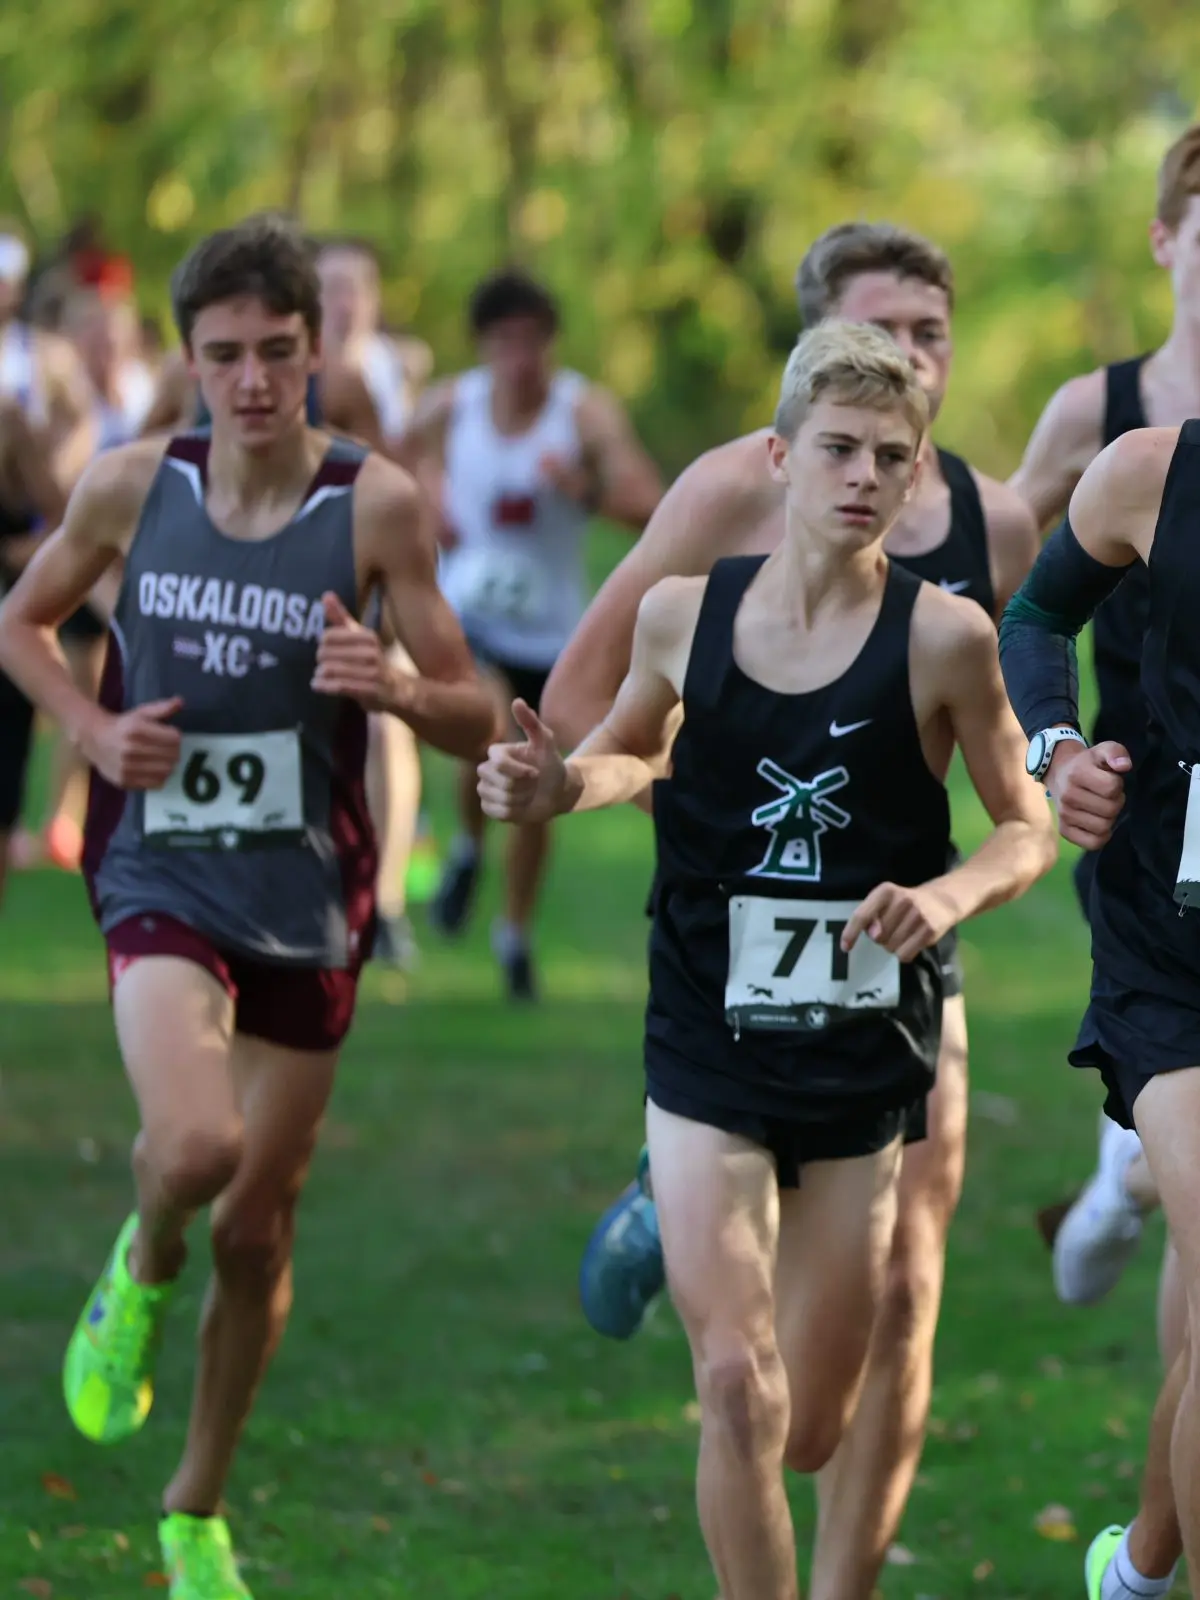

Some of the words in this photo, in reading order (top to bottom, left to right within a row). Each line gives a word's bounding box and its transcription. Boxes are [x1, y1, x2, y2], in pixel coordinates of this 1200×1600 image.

[139, 571, 325, 641] OSKALOOSA
[201, 629, 250, 678] XC
[182, 750, 265, 806] 69
[772, 917, 849, 982] 71
